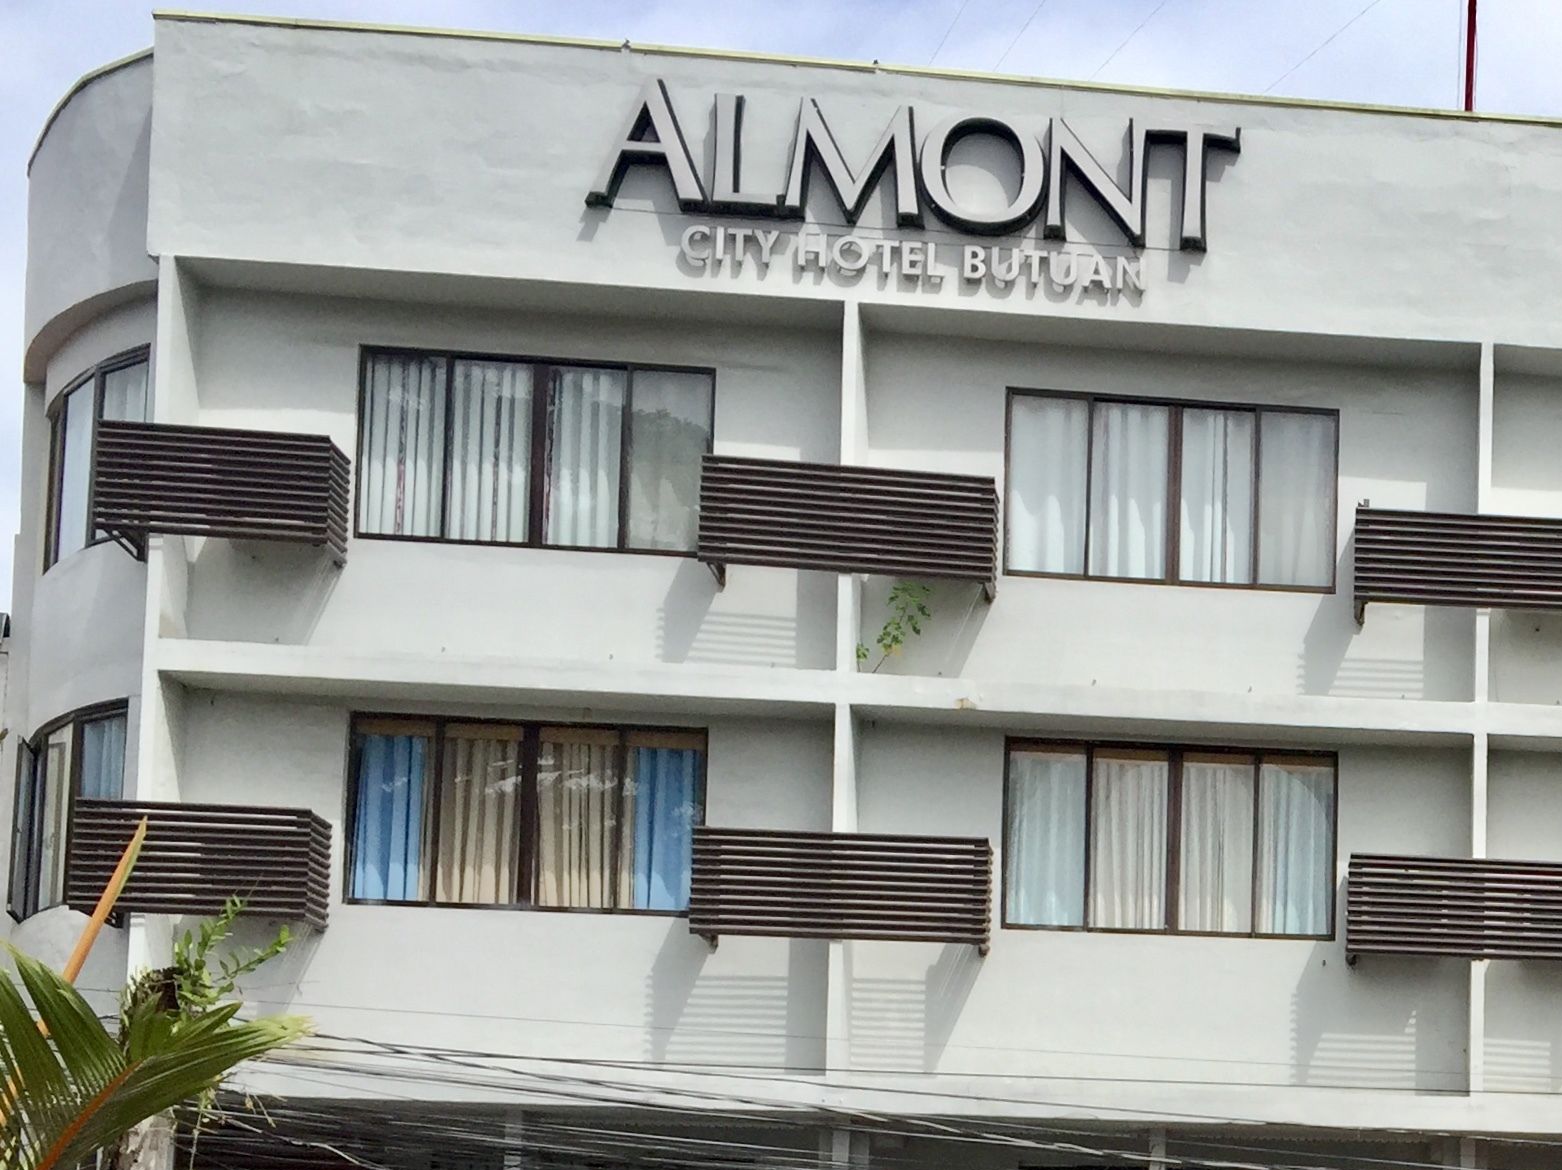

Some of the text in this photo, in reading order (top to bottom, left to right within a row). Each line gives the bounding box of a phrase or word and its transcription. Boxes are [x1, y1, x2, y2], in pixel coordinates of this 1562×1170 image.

[585, 78, 1241, 252] ALMONT
[681, 224, 1146, 291] CITY HOTEL BUTUAN
